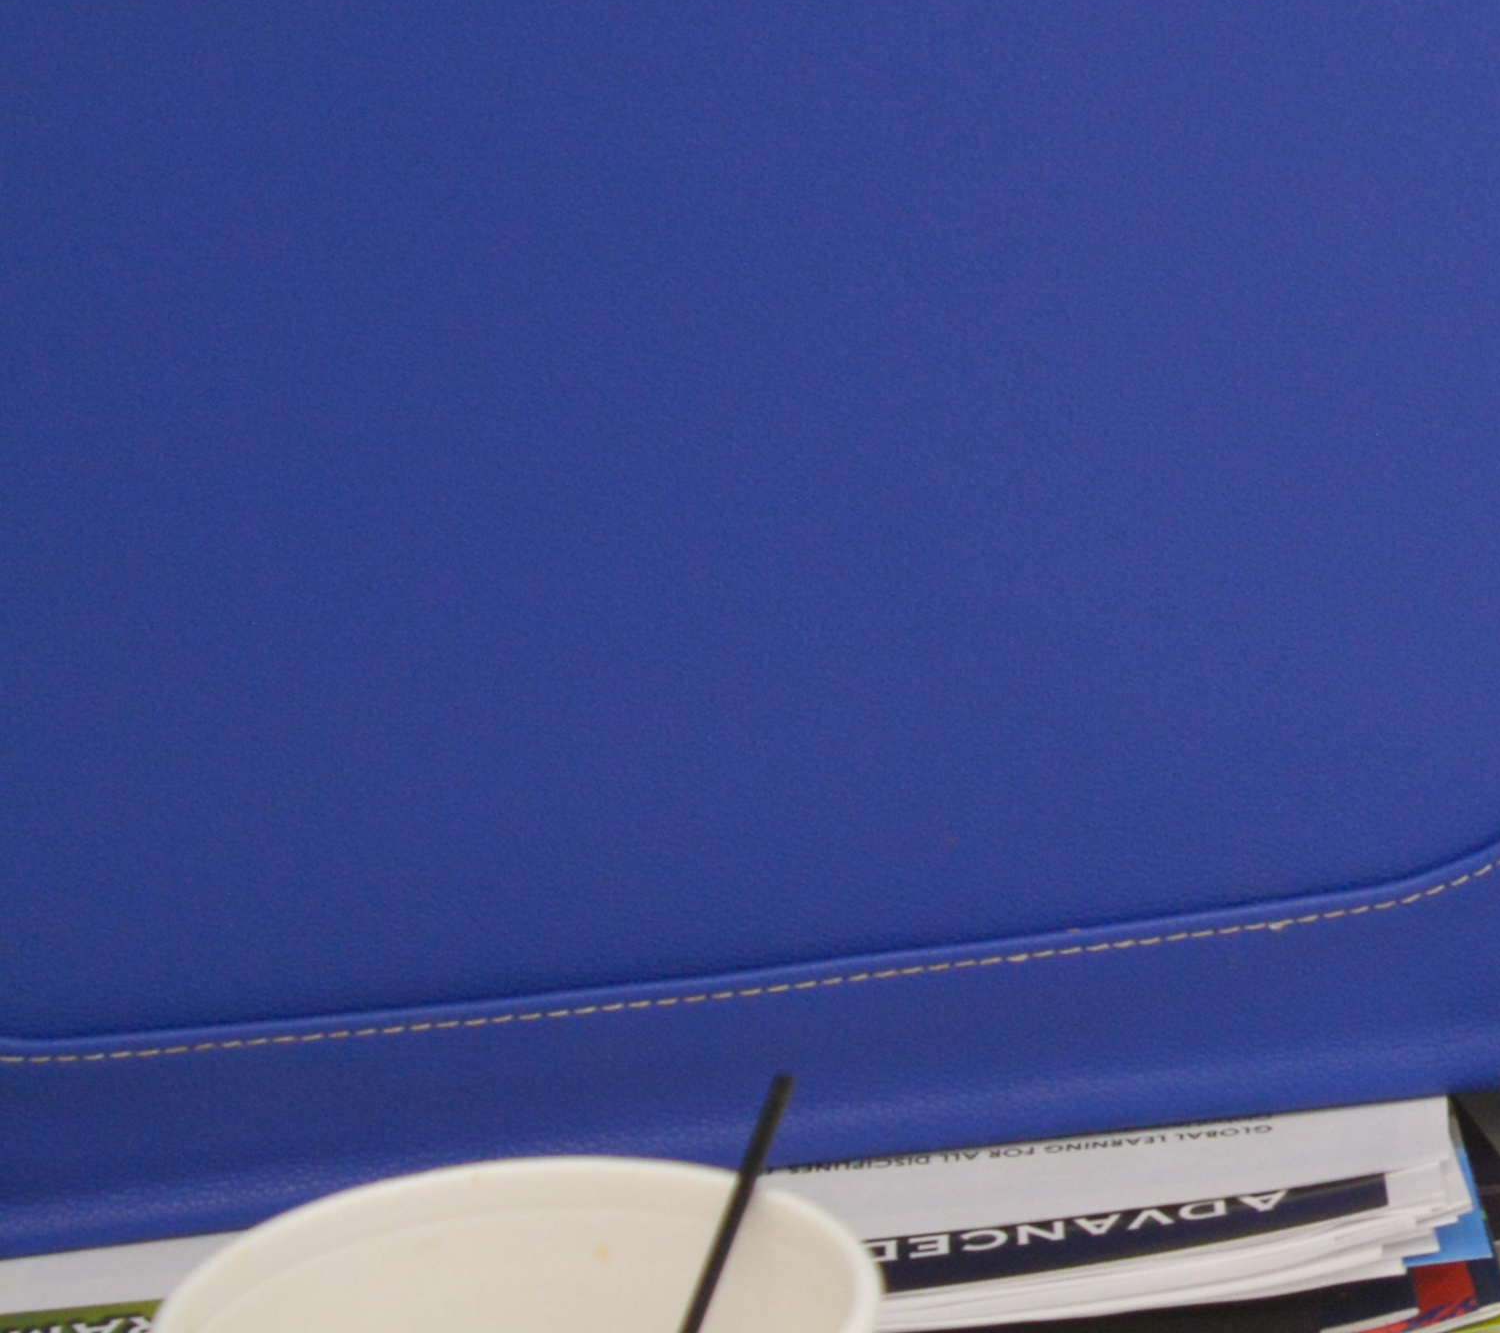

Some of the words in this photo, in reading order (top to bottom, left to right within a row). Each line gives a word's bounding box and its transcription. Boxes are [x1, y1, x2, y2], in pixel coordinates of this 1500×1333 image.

[1173, 1123, 1274, 1143] GLOBAL
[986, 1144, 1036, 1160] FOR
[1042, 1134, 1168, 1155] LEARNING
[937, 1151, 979, 1166] ALL
[860, 1189, 1289, 1262] ADVANCED
